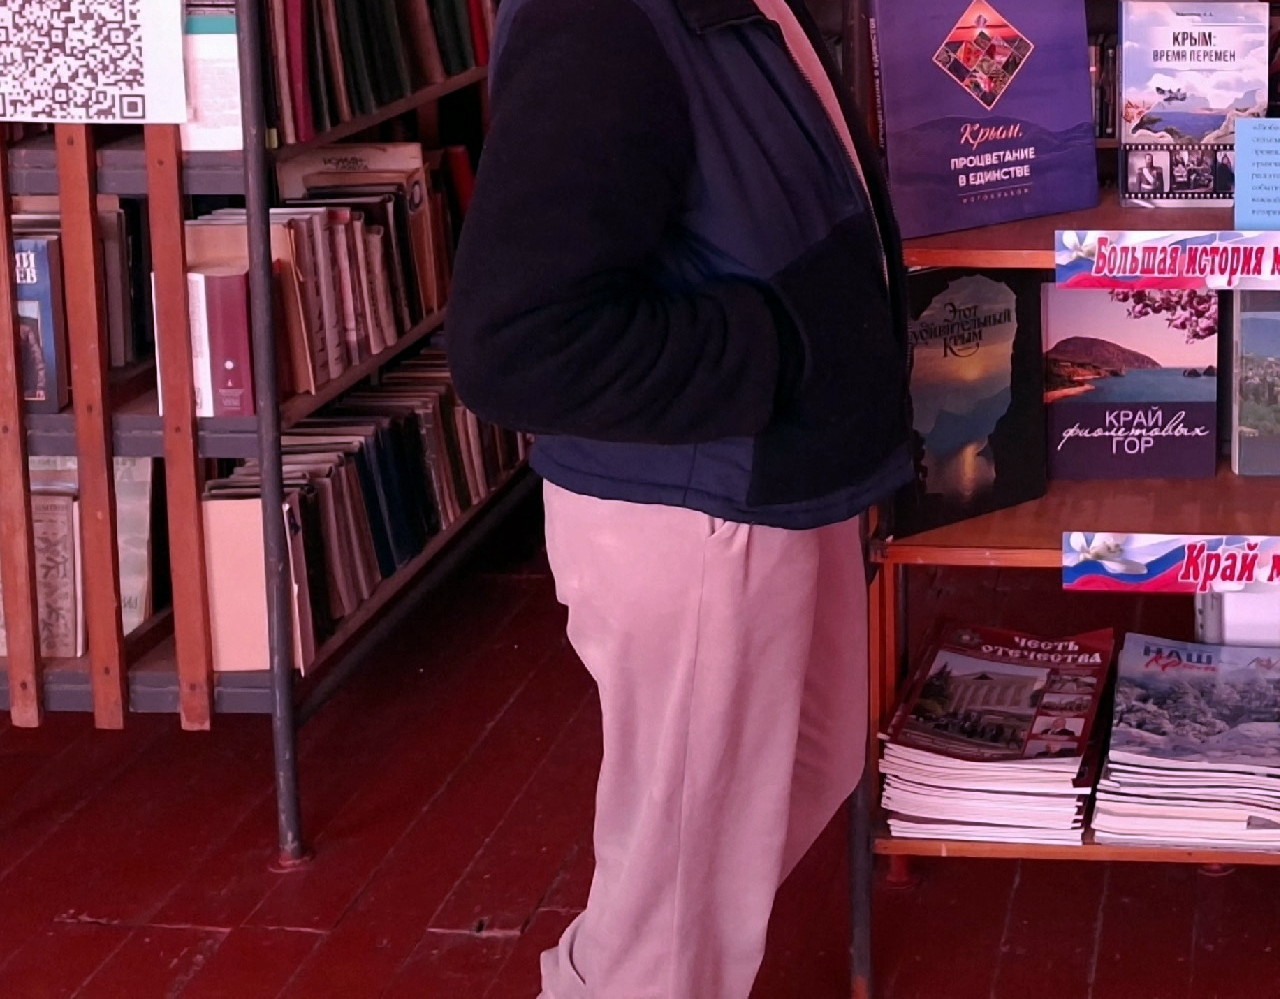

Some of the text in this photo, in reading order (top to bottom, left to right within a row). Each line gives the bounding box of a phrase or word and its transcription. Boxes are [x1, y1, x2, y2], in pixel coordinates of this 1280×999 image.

[1172, 31, 1217, 46] КРЫМ:
[1153, 50, 1237, 63] ВРЕМЯ ПЕРЕМЕН
[960, 123, 1023, 150] Крым.
[951, 147, 1036, 170] ПРОЦВЕТАНИЕ
[958, 165, 1031, 187] В ЕДИНСТВЕ
[1093, 238, 1179, 276] Большая
[1185, 245, 1265, 285] история
[943, 302, 979, 323] Этот
[1105, 406, 1163, 427] КРАЙ
[1057, 411, 1210, 451] фиолетовых
[1112, 437, 1155, 454] ГОР
[1179, 543, 1259, 592] Край
[981, 644, 1104, 665] ОТЕЧЕСТВА
[1013, 636, 1080, 652] ЧЕСТЬ
[1143, 645, 1213, 666] НАШ
